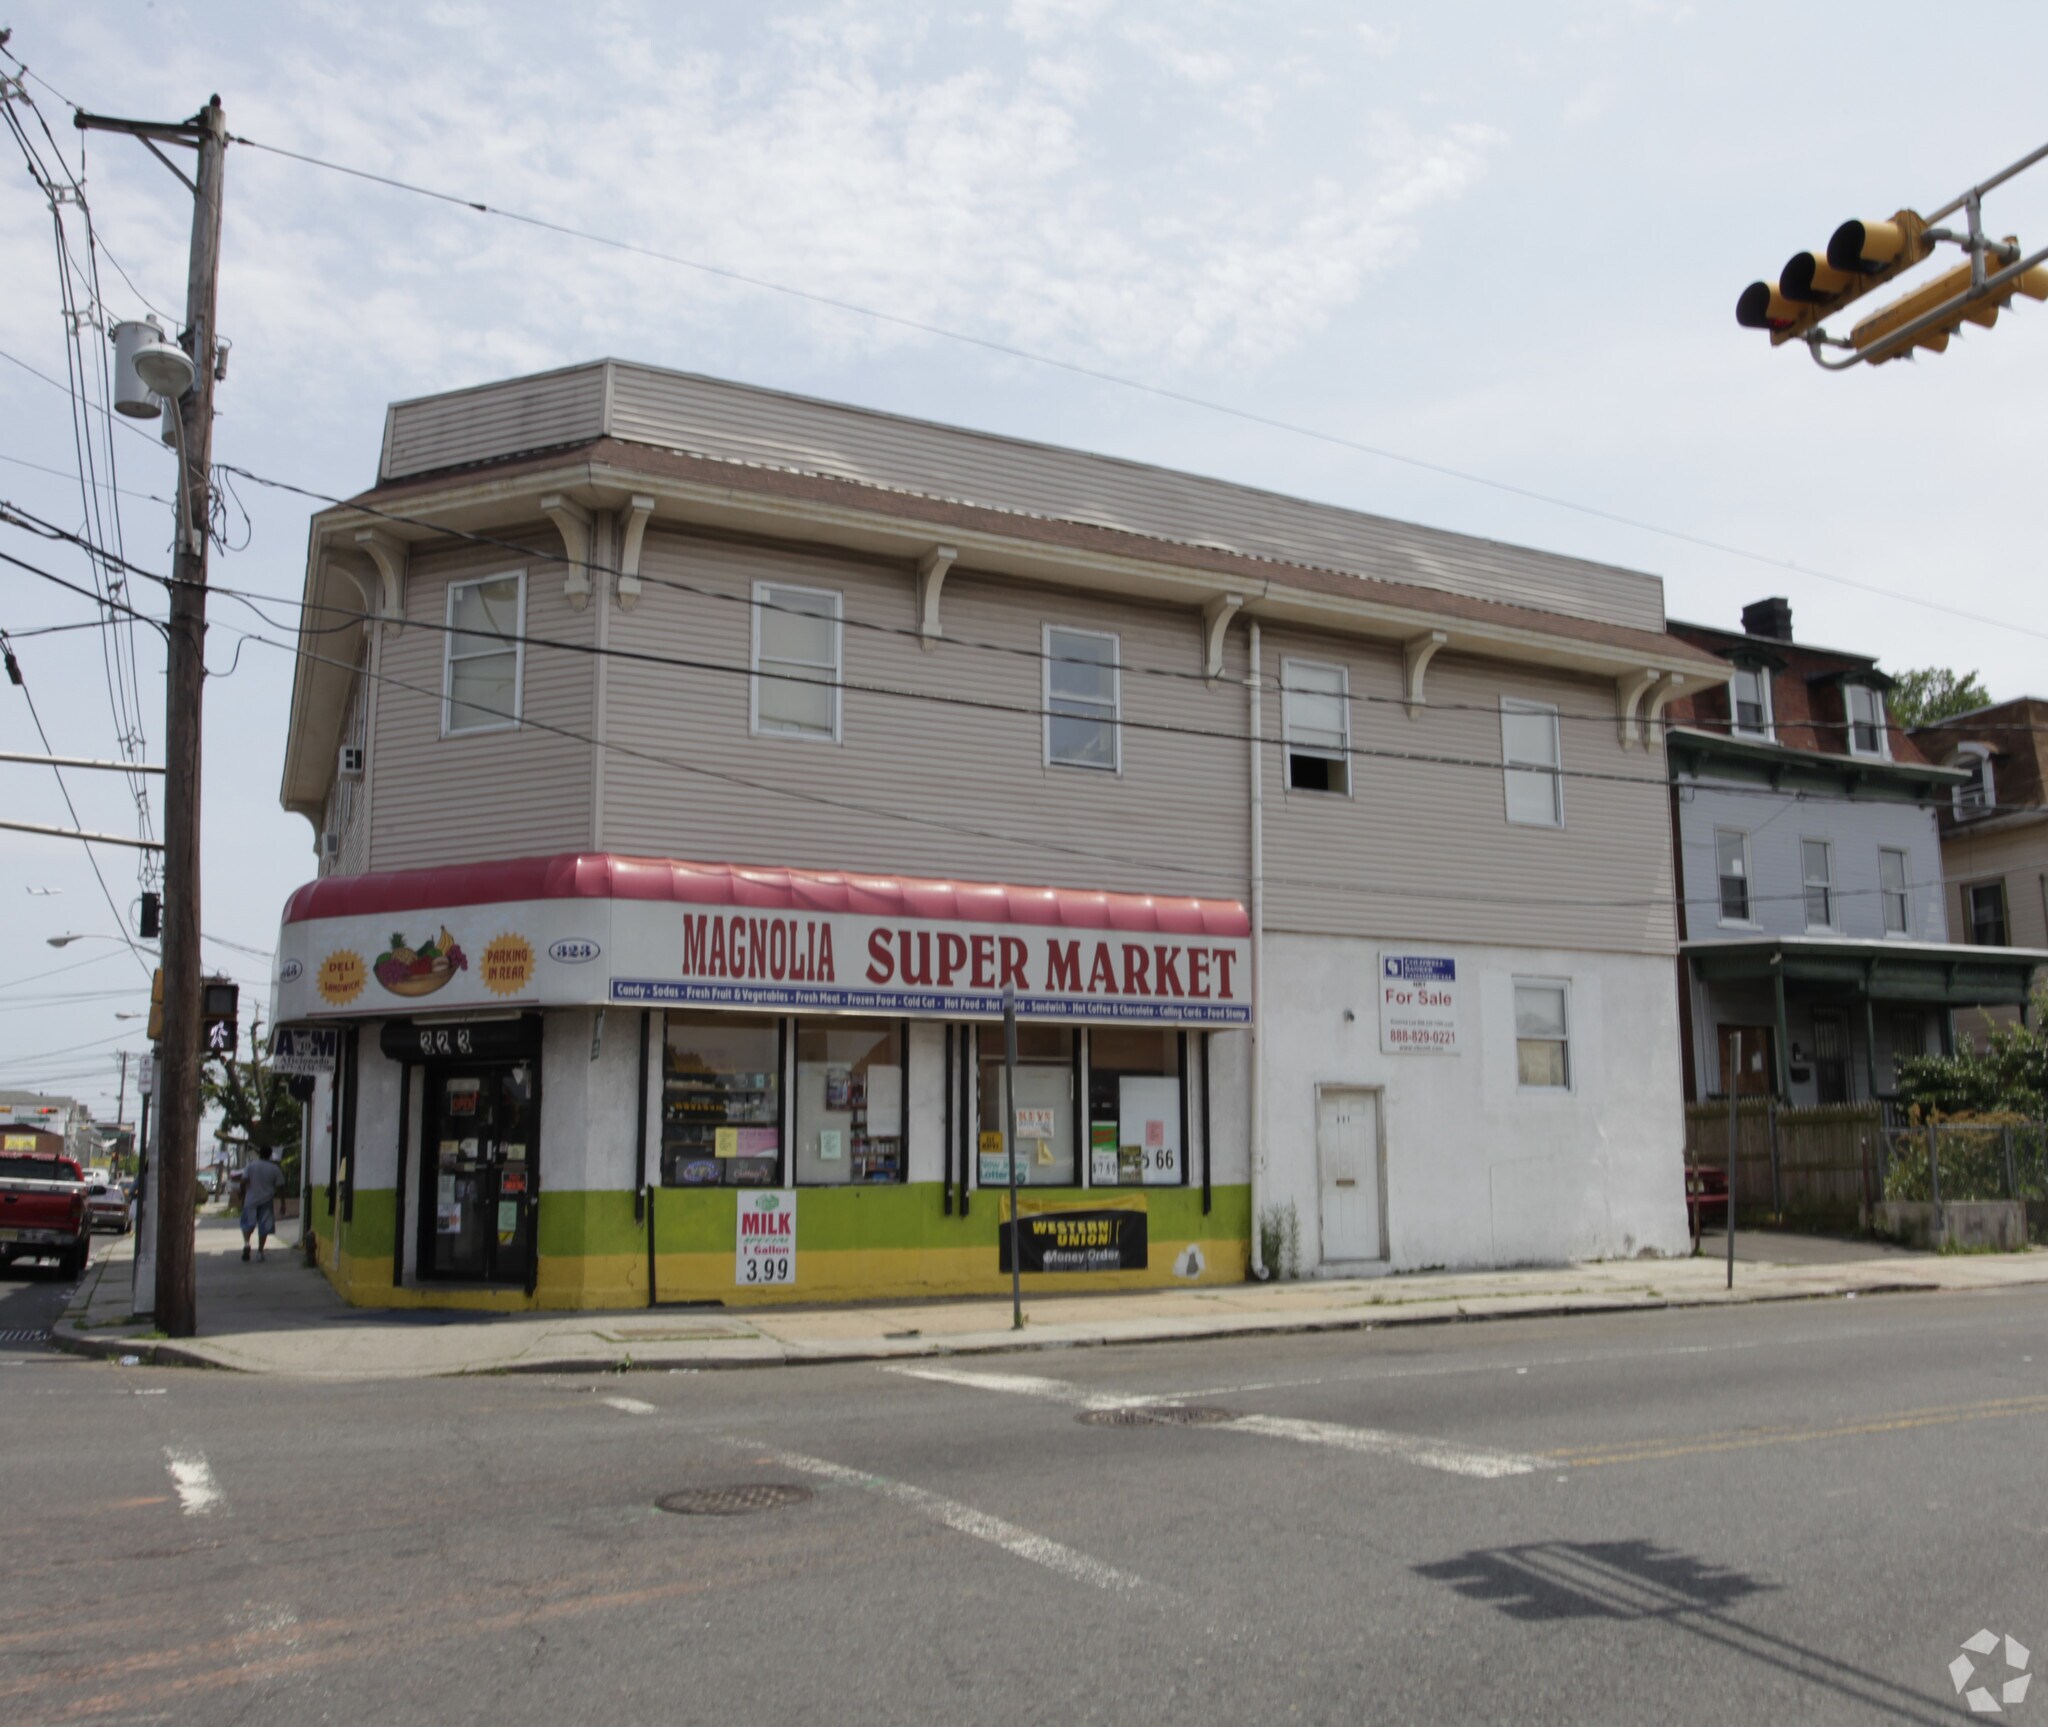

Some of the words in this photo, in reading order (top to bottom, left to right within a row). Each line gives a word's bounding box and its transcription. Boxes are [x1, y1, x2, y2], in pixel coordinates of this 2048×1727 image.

[487, 948, 528, 964] PARKING
[557, 944, 592, 958] 323
[683, 913, 835, 982] MAGNOLIA
[865, 927, 1030, 990] SUPER
[1045, 938, 1237, 999] MARKET
[329, 961, 355, 973] DELI
[488, 967, 497, 980] IN
[499, 966, 525, 981] REAR
[324, 979, 360, 993] SANDWICH
[617, 983, 645, 998] Candy
[652, 984, 679, 998] Sodas
[686, 986, 710, 1000] Fresh
[712, 987, 732, 1000] Fruit
[734, 988, 742, 1000] &
[742, 988, 788, 1004] Vegetables
[795, 991, 818, 1004] Fresh
[820, 993, 841, 1005] Meat
[847, 993, 875, 1006] Frozen
[876, 994, 897, 1007] Food
[903, 995, 921, 1008] Cold
[922, 996, 936, 1009] Cut
[944, 998, 959, 1010] Hot
[960, 998, 980, 1010] Food
[986, 998, 1000, 1011] Hot
[1031, 1001, 1067, 1014] Sandwich
[1072, 1002, 1086, 1014] Hot
[1087, 1002, 1112, 1015] Coffee
[1119, 1004, 1154, 1017] Chocolate
[1159, 1006, 1182, 1020] Calling
[1183, 1006, 1202, 1019] Cards
[1207, 1007, 1225, 1019] Food
[1226, 1008, 1246, 1021] Stamp
[1386, 988, 1412, 1005] For
[1418, 989, 1452, 1006] Sale
[741, 1212, 792, 1236] MILK
[1032, 1220, 1109, 1235] WESTERN
[1057, 1234, 1108, 1247] UNION
[743, 1246, 748, 1255] 1
[754, 1244, 790, 1255] Gallon
[1043, 1249, 1085, 1264] Money
[1087, 1248, 1120, 1261] Order
